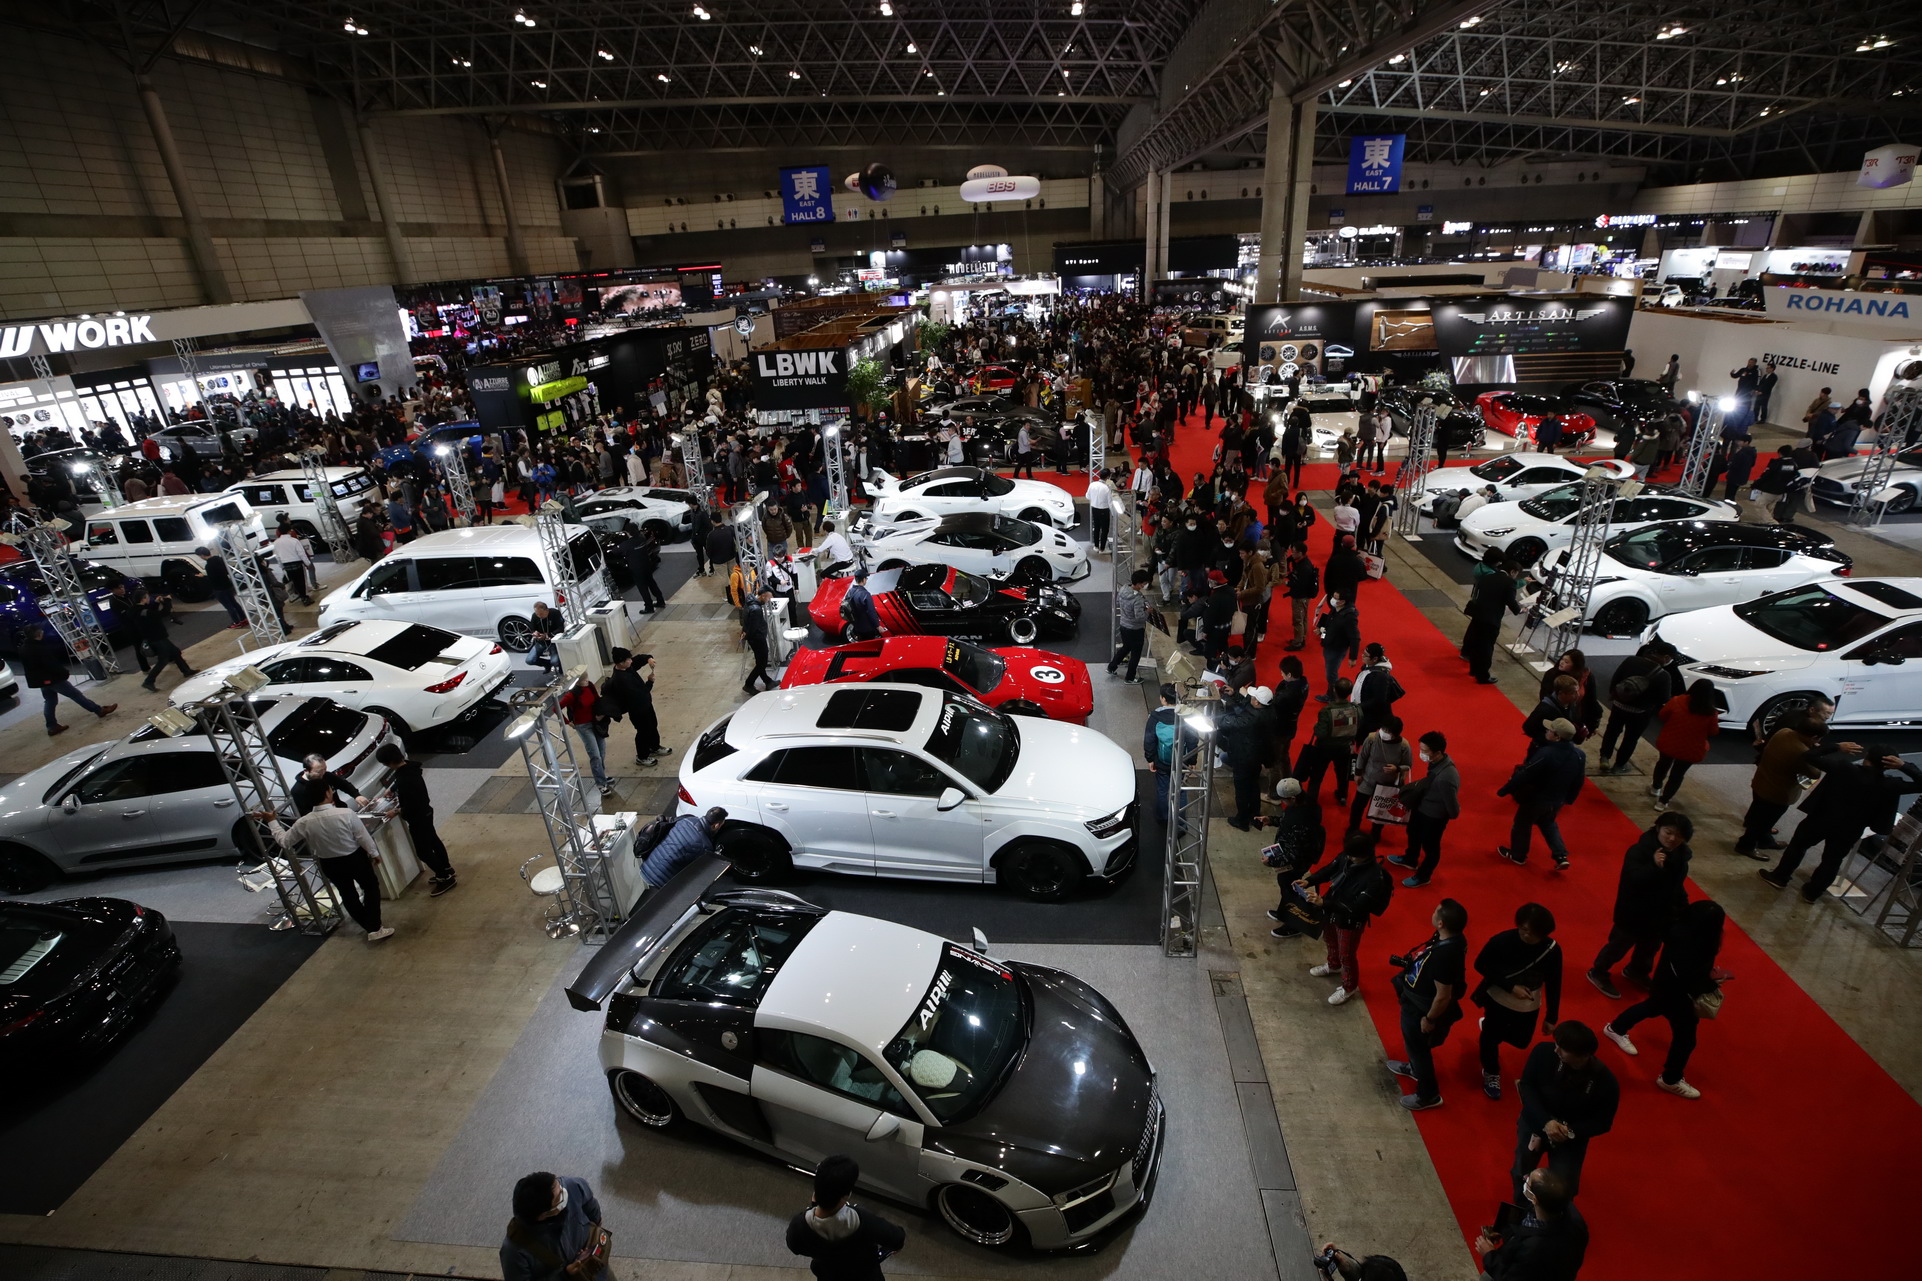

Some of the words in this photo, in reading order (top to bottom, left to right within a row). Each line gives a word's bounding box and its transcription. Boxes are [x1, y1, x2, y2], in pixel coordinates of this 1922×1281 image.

[1361, 138, 1393, 169] 東
[791, 171, 820, 200] 東
[986, 181, 1016, 193] BBS
[1354, 181, 1380, 191] HALL
[1382, 177, 1393, 190] 7
[791, 212, 816, 221] HALL
[816, 206, 826, 219] 8
[1787, 294, 1910, 319] ROHANA
[1488, 308, 1575, 321] ARTISAN
[38, 315, 157, 353] WORK
[689, 333, 709, 347] ZERO
[757, 351, 838, 378] LBWK
[1762, 353, 1840, 375] EXIZZLE-LINE
[772, 378, 803, 387] LIBERTY
[804, 376, 827, 386] WALK
[1034, 670, 1062, 680] 3
